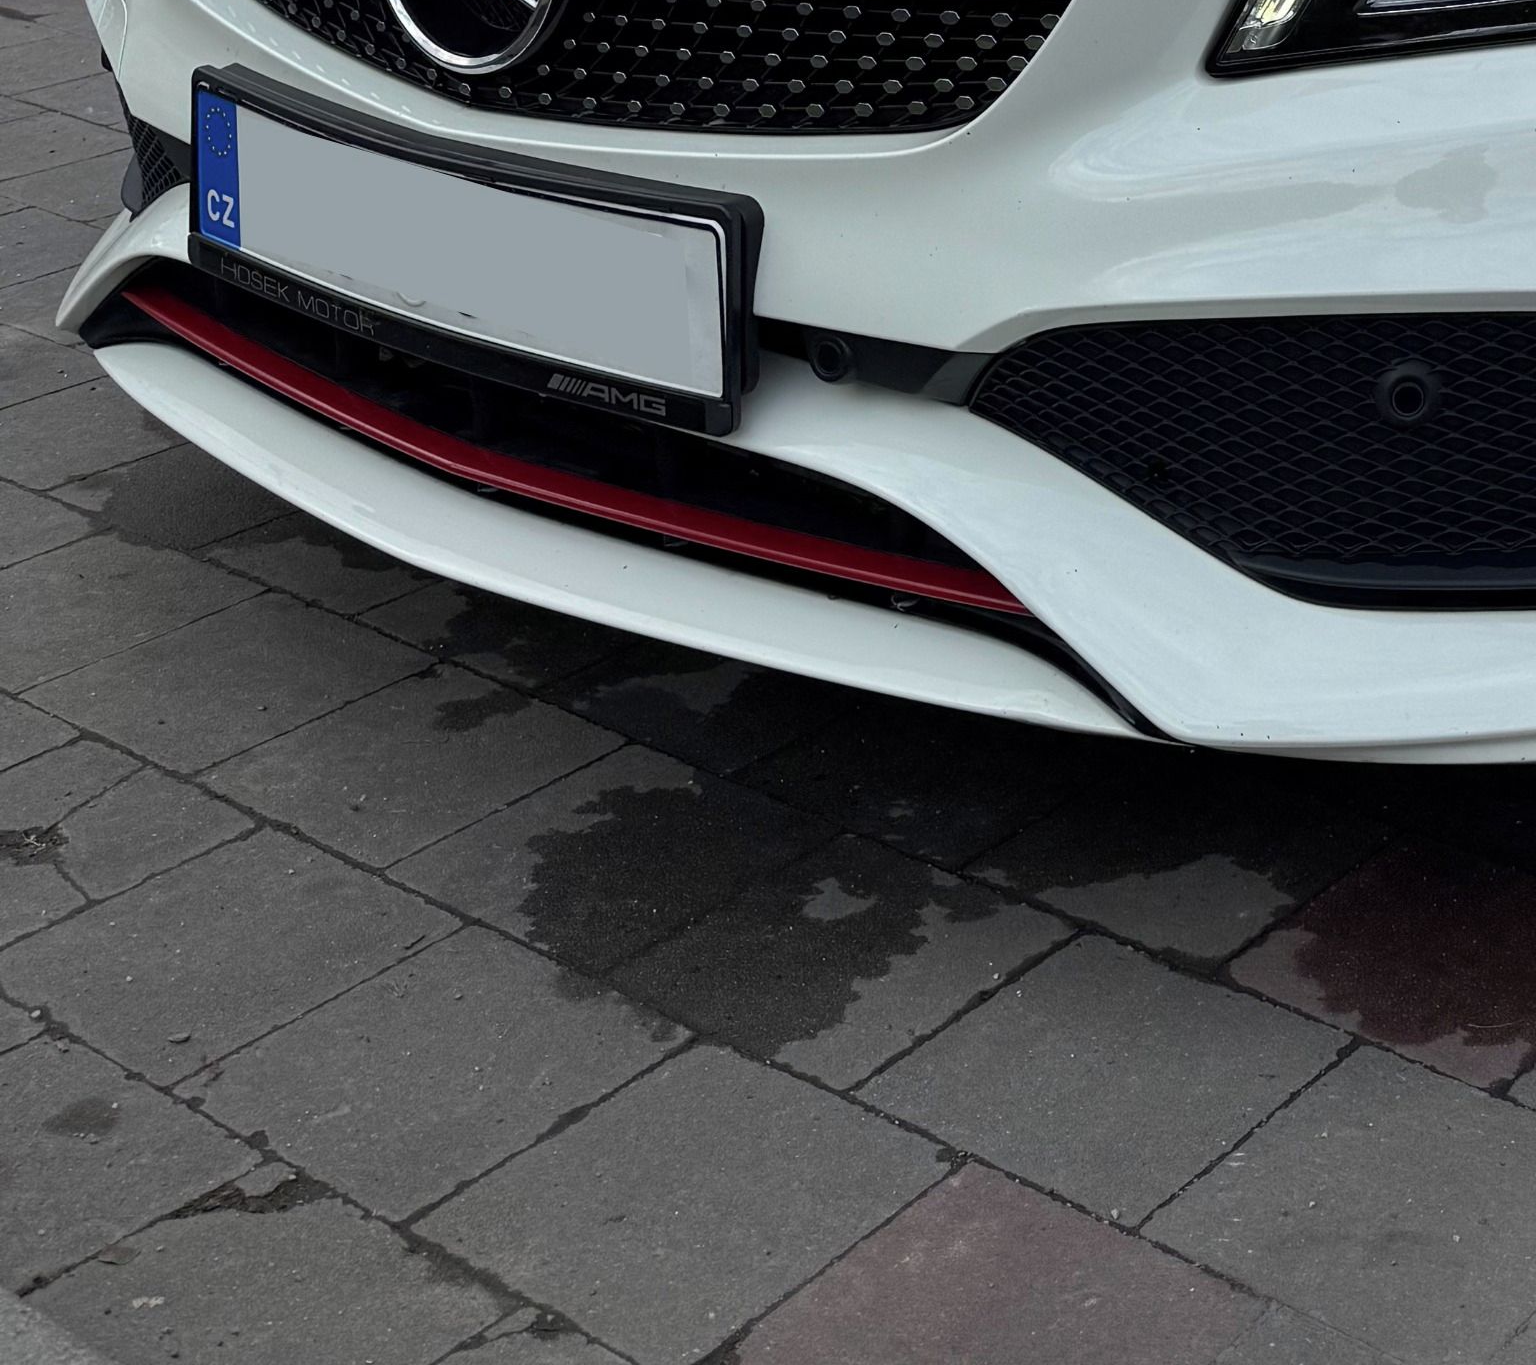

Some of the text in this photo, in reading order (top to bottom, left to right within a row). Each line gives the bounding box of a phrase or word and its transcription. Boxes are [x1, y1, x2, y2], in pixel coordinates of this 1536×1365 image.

[207, 189, 235, 228] CZ
[220, 257, 375, 336] HOSEK MOTOR
[581, 381, 666, 417] AMG
